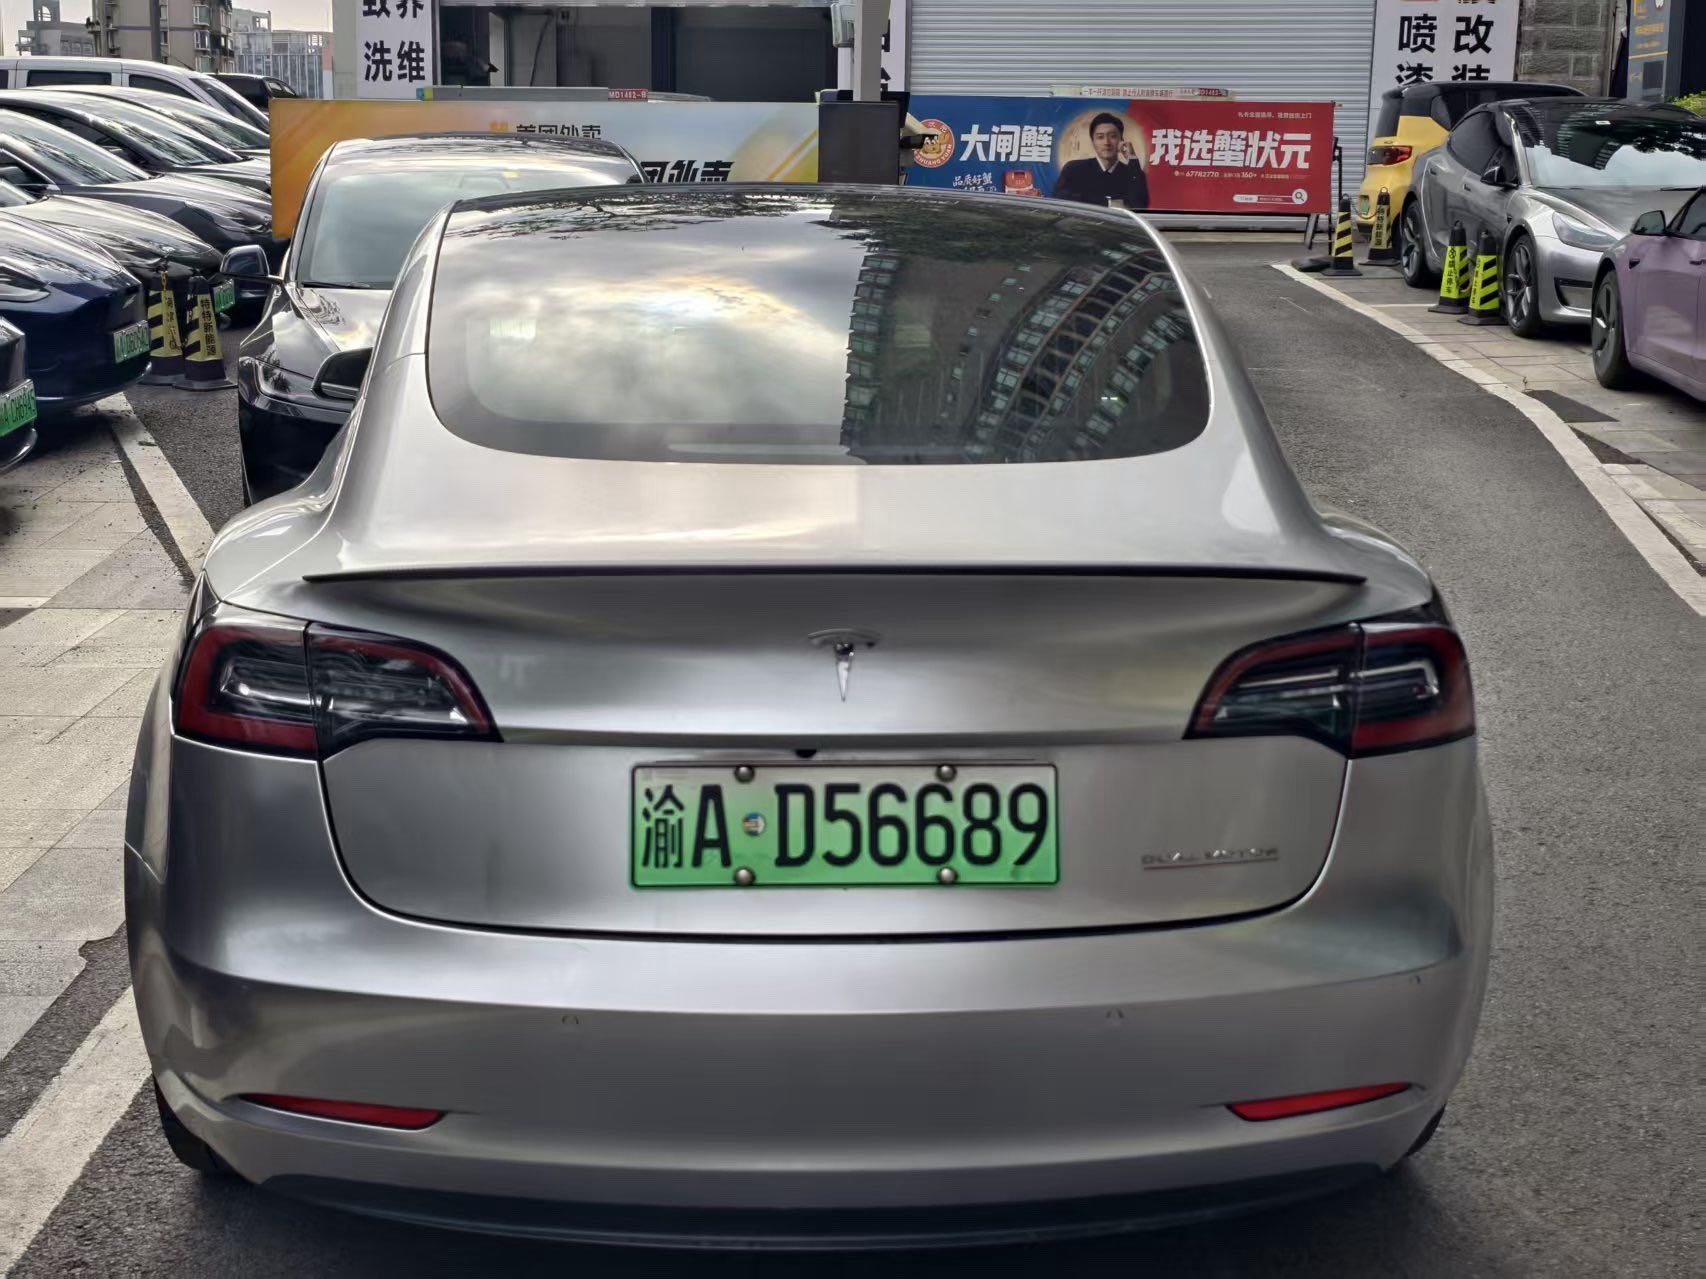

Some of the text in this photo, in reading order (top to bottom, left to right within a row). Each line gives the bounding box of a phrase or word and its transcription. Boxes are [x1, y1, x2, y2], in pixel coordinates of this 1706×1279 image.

[959, 124, 1054, 162] 大闸蟹
[1149, 128, 1312, 169] 我选蟹状元
